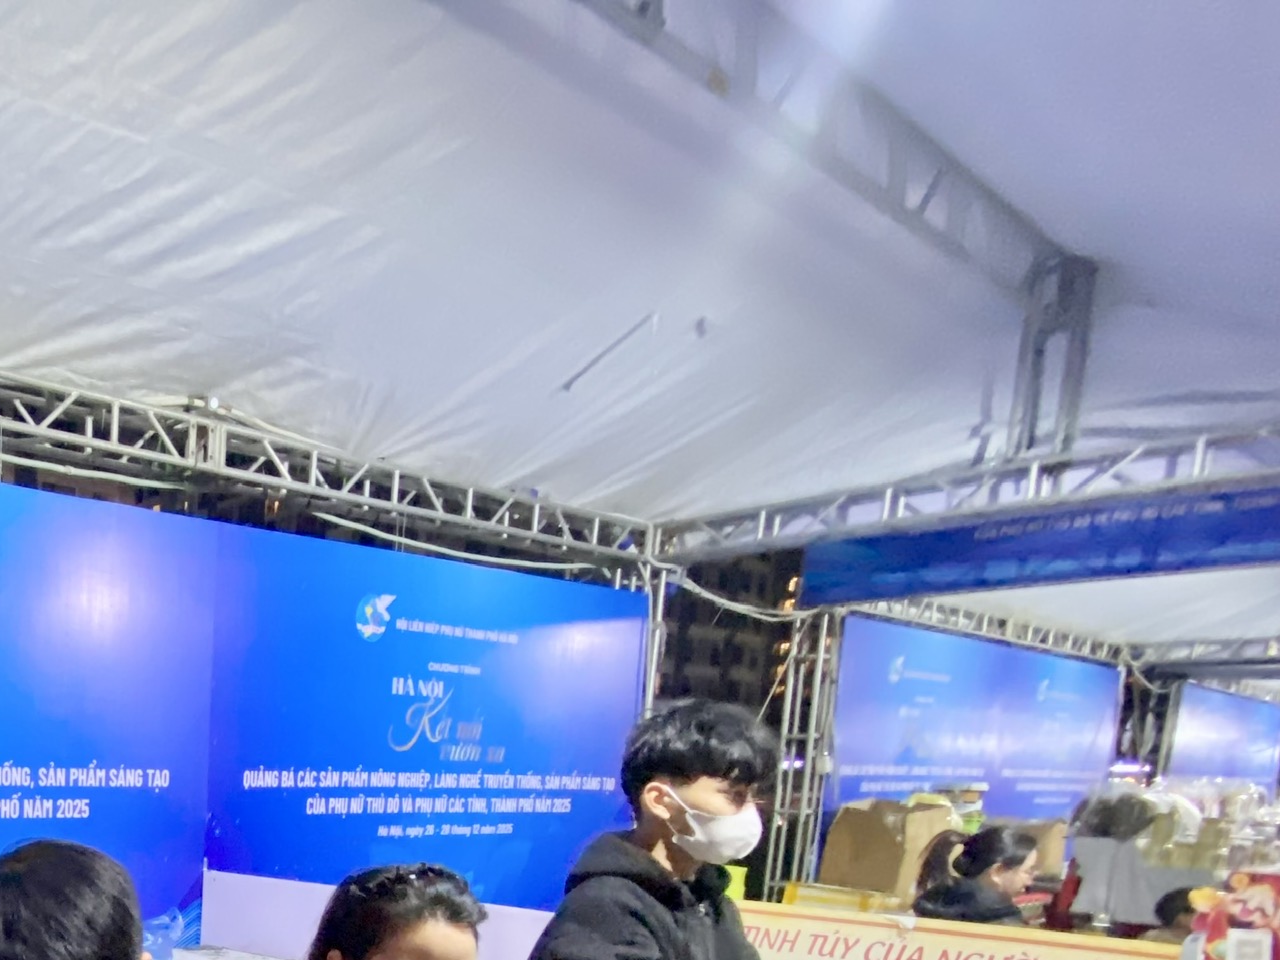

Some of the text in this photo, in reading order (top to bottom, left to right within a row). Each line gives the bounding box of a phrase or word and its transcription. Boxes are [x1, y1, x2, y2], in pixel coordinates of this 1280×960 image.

[392, 674, 415, 696] HÀ
[38, 762, 66, 787] SẢN
[69, 759, 106, 788] PHẨM
[109, 764, 143, 788] SÁNG
[146, 768, 170, 793] TẠO
[243, 765, 279, 790] QUẢNG
[281, 766, 294, 788] BÁ
[297, 767, 317, 788] CÁC
[319, 766, 339, 787] SẢN
[341, 764, 368, 788] PHẨM
[370, 768, 396, 788] NÔNG
[23, 794, 53, 819] NĂM
[56, 799, 90, 819] 2025
[306, 793, 326, 815] CỦA
[328, 797, 348, 819] PHỤ
[350, 793, 366, 814] NỮ
